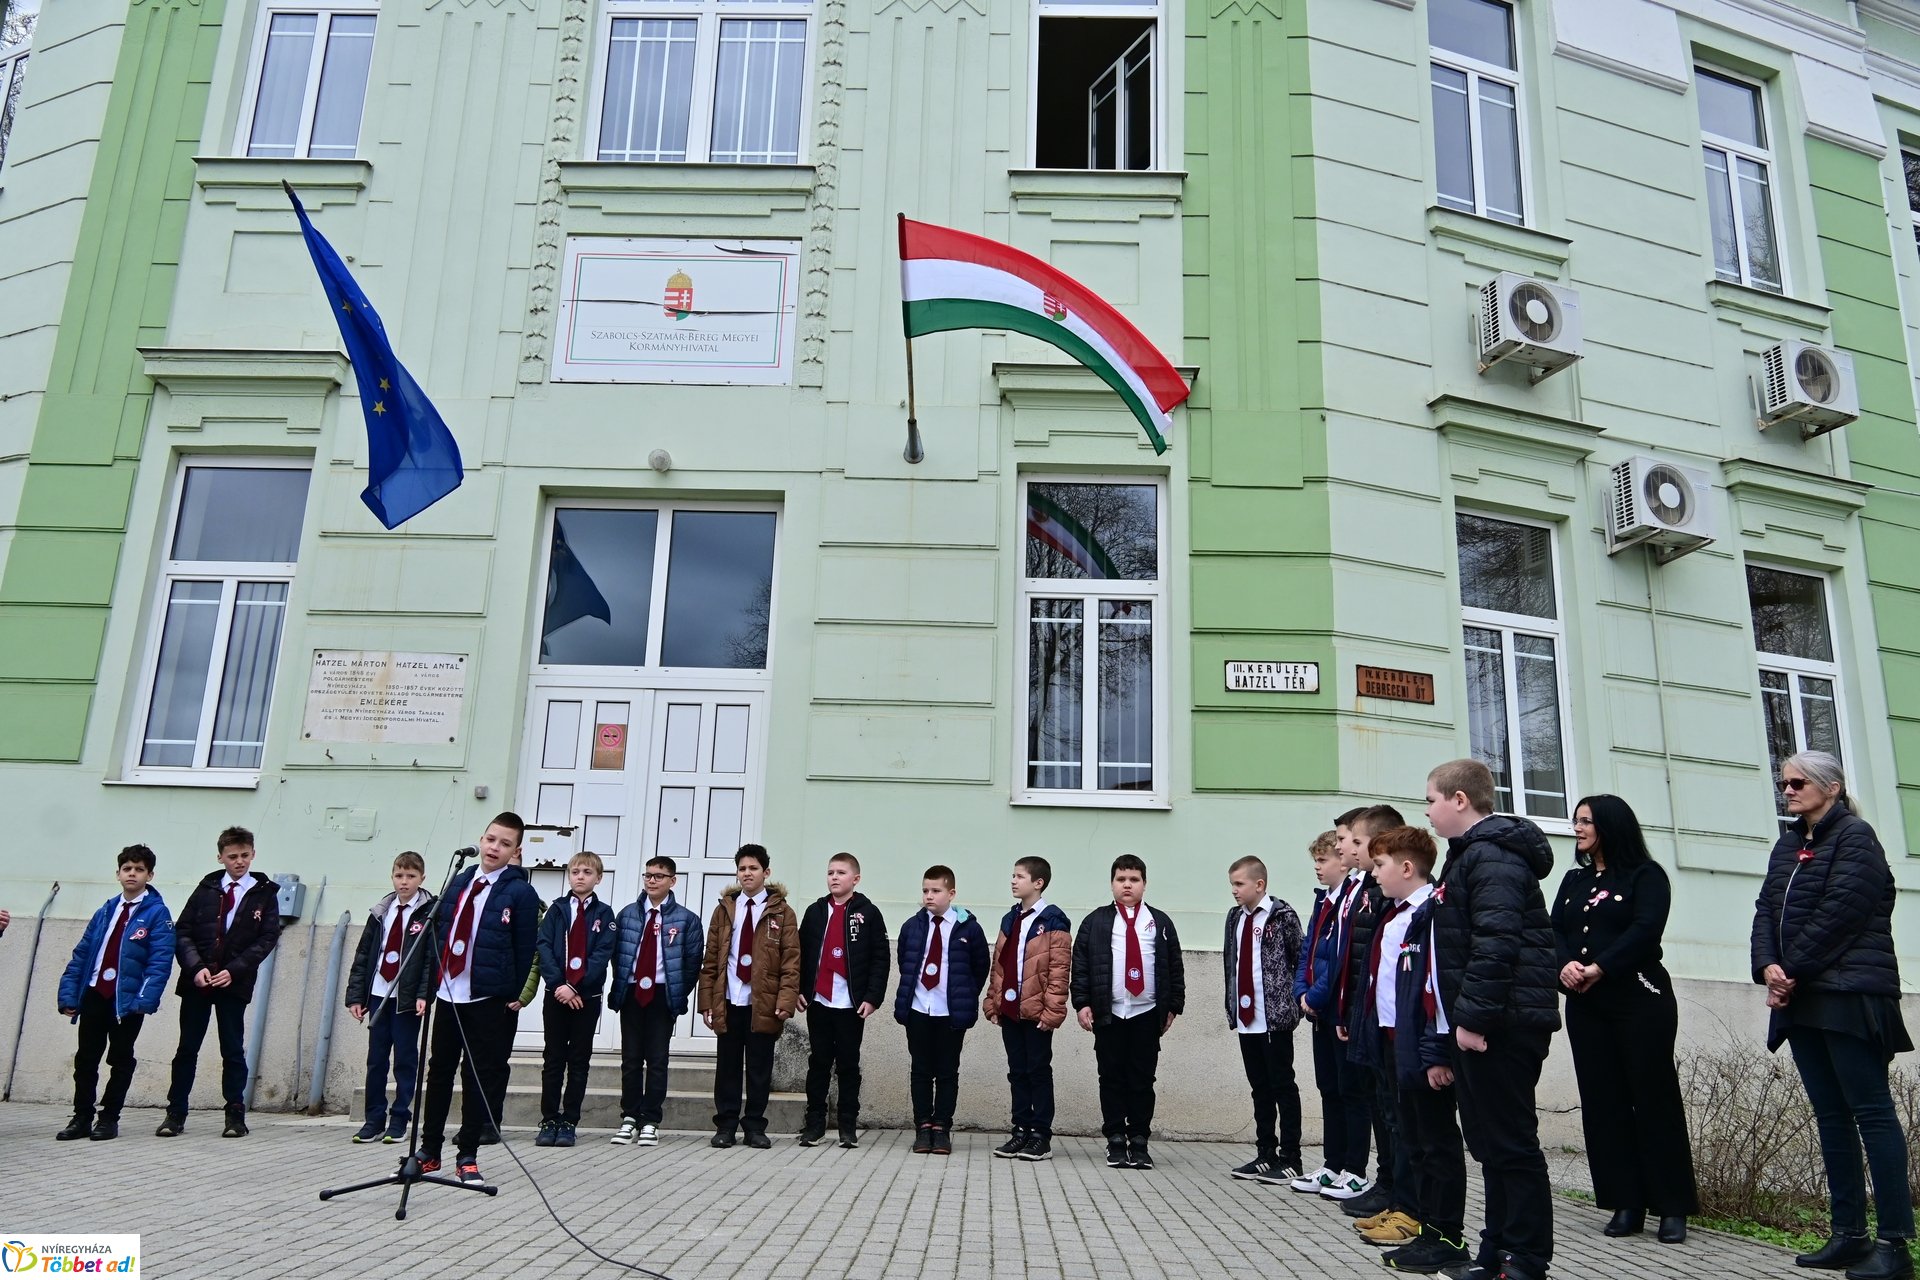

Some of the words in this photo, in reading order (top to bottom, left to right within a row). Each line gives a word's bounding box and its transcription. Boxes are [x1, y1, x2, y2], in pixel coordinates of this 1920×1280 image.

[721, 333, 759, 342] MEGYEI
[629, 342, 719, 352] KORMÁNYHIVATAL
[315, 659, 348, 667] HATZEL
[351, 658, 387, 668] MÁRTON
[396, 661, 429, 669] HATZEL
[1235, 675, 1276, 689] HATZEL
[1284, 673, 1305, 689] TÉR
[1366, 681, 1409, 698] DEBRECENI
[1415, 685, 1425, 700] ÚT
[360, 697, 408, 706] EMLÉKÉRE
